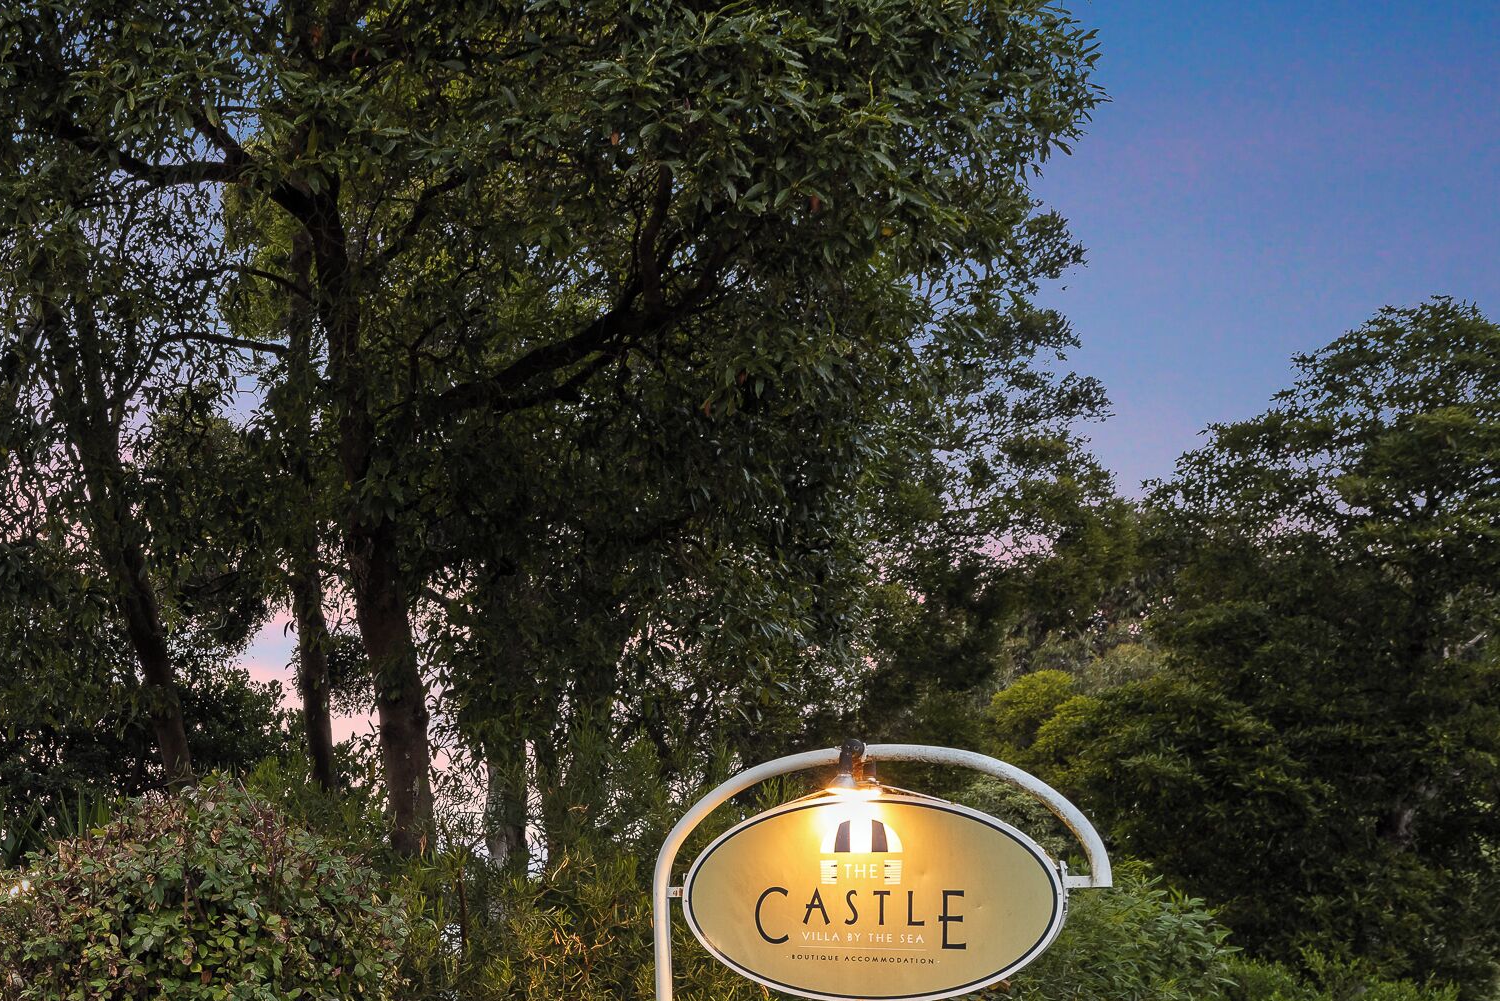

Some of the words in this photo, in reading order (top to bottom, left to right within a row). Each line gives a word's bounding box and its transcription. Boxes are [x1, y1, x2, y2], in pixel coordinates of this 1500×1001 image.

[843, 863, 878, 879] THE
[754, 886, 967, 950] CASTLE
[801, 931, 840, 942] VILLA
[847, 933, 861, 942] BY
[868, 933, 893, 943] THE
[900, 933, 925, 944] SEA
[844, 955, 934, 965] ACCOMMODATION
